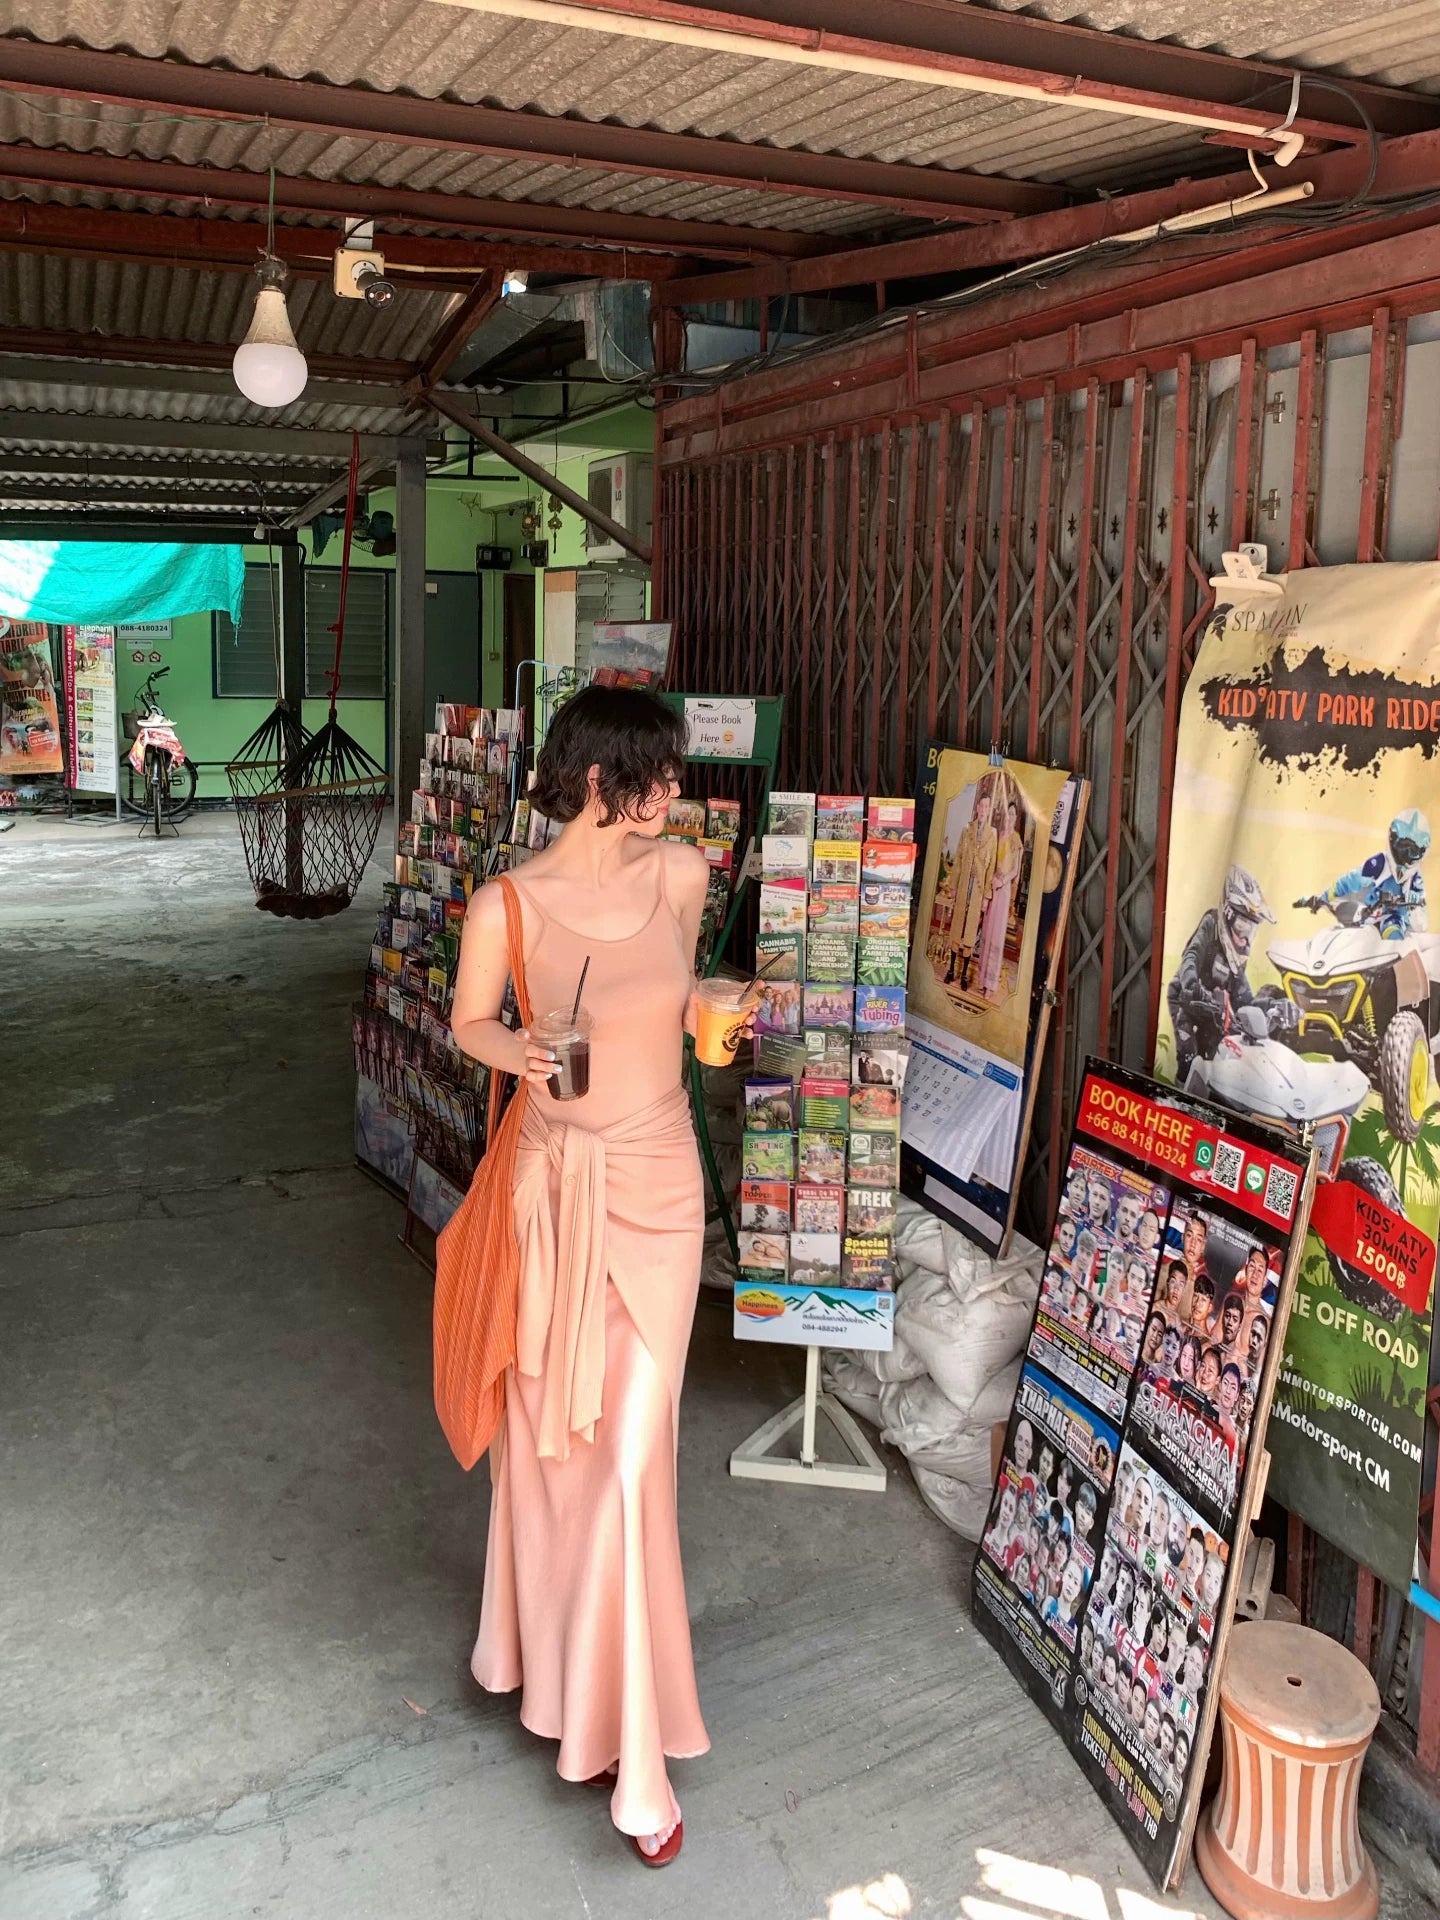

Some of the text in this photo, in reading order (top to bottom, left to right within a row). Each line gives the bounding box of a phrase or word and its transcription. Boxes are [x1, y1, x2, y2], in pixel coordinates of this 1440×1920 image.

[693, 713, 742, 725] Please Book
[1265, 690, 1308, 720] ATV
[1318, 693, 1375, 727] PARK
[1386, 697, 1440, 732] RIDE
[700, 733, 720, 744] Here
[759, 938, 796, 947] CANNABIS
[861, 1009, 900, 1025] Tubing
[866, 1000, 888, 1008] RIVER
[1088, 1082, 1193, 1149] BOOK HERE
[1085, 1107, 1187, 1169] +66 88 418 0324
[1072, 1147, 1119, 1182] FAIRTEX
[851, 1189, 893, 1208] TREK
[845, 1237, 888, 1248] Special
[1224, 1233, 1248, 1253] STADIUM
[1357, 1199, 1427, 1259] KIDS' ATV
[845, 1246, 888, 1256] Program
[1362, 1224, 1418, 1274] 30MINS
[742, 1300, 779, 1310] Happiness
[1316, 1301, 1358, 1335] OFF
[1362, 1320, 1420, 1370] ROAD
[1019, 1383, 1090, 1449] THAPHAE BOXING
[1065, 1433, 1089, 1464] STADIUM
[1159, 1431, 1225, 1503] SORYING ARENA
[1364, 1457, 1391, 1492] CM
[1160, 1481, 1192, 1520] COMPETITION
[1071, 1534, 1094, 1569] Thailand
[1050, 1614, 1073, 1650] Thailand
[1176, 1600, 1194, 1625] GERMANY
[1196, 1623, 1210, 1644] CHINA
[1093, 1685, 1126, 1732] INTERNATIONAL
[1132, 1734, 1144, 1756] THAI
[1144, 1748, 1162, 1778] BOXING
[1104, 1710, 1120, 1738] START
[1138, 1753, 1147, 1772] PM
[1079, 1724, 1107, 1770] TICKETS
[1143, 1810, 1157, 1842] THB
[1109, 1741, 1134, 1787] BOXING
[1132, 1773, 1162, 1826] STADIUM
